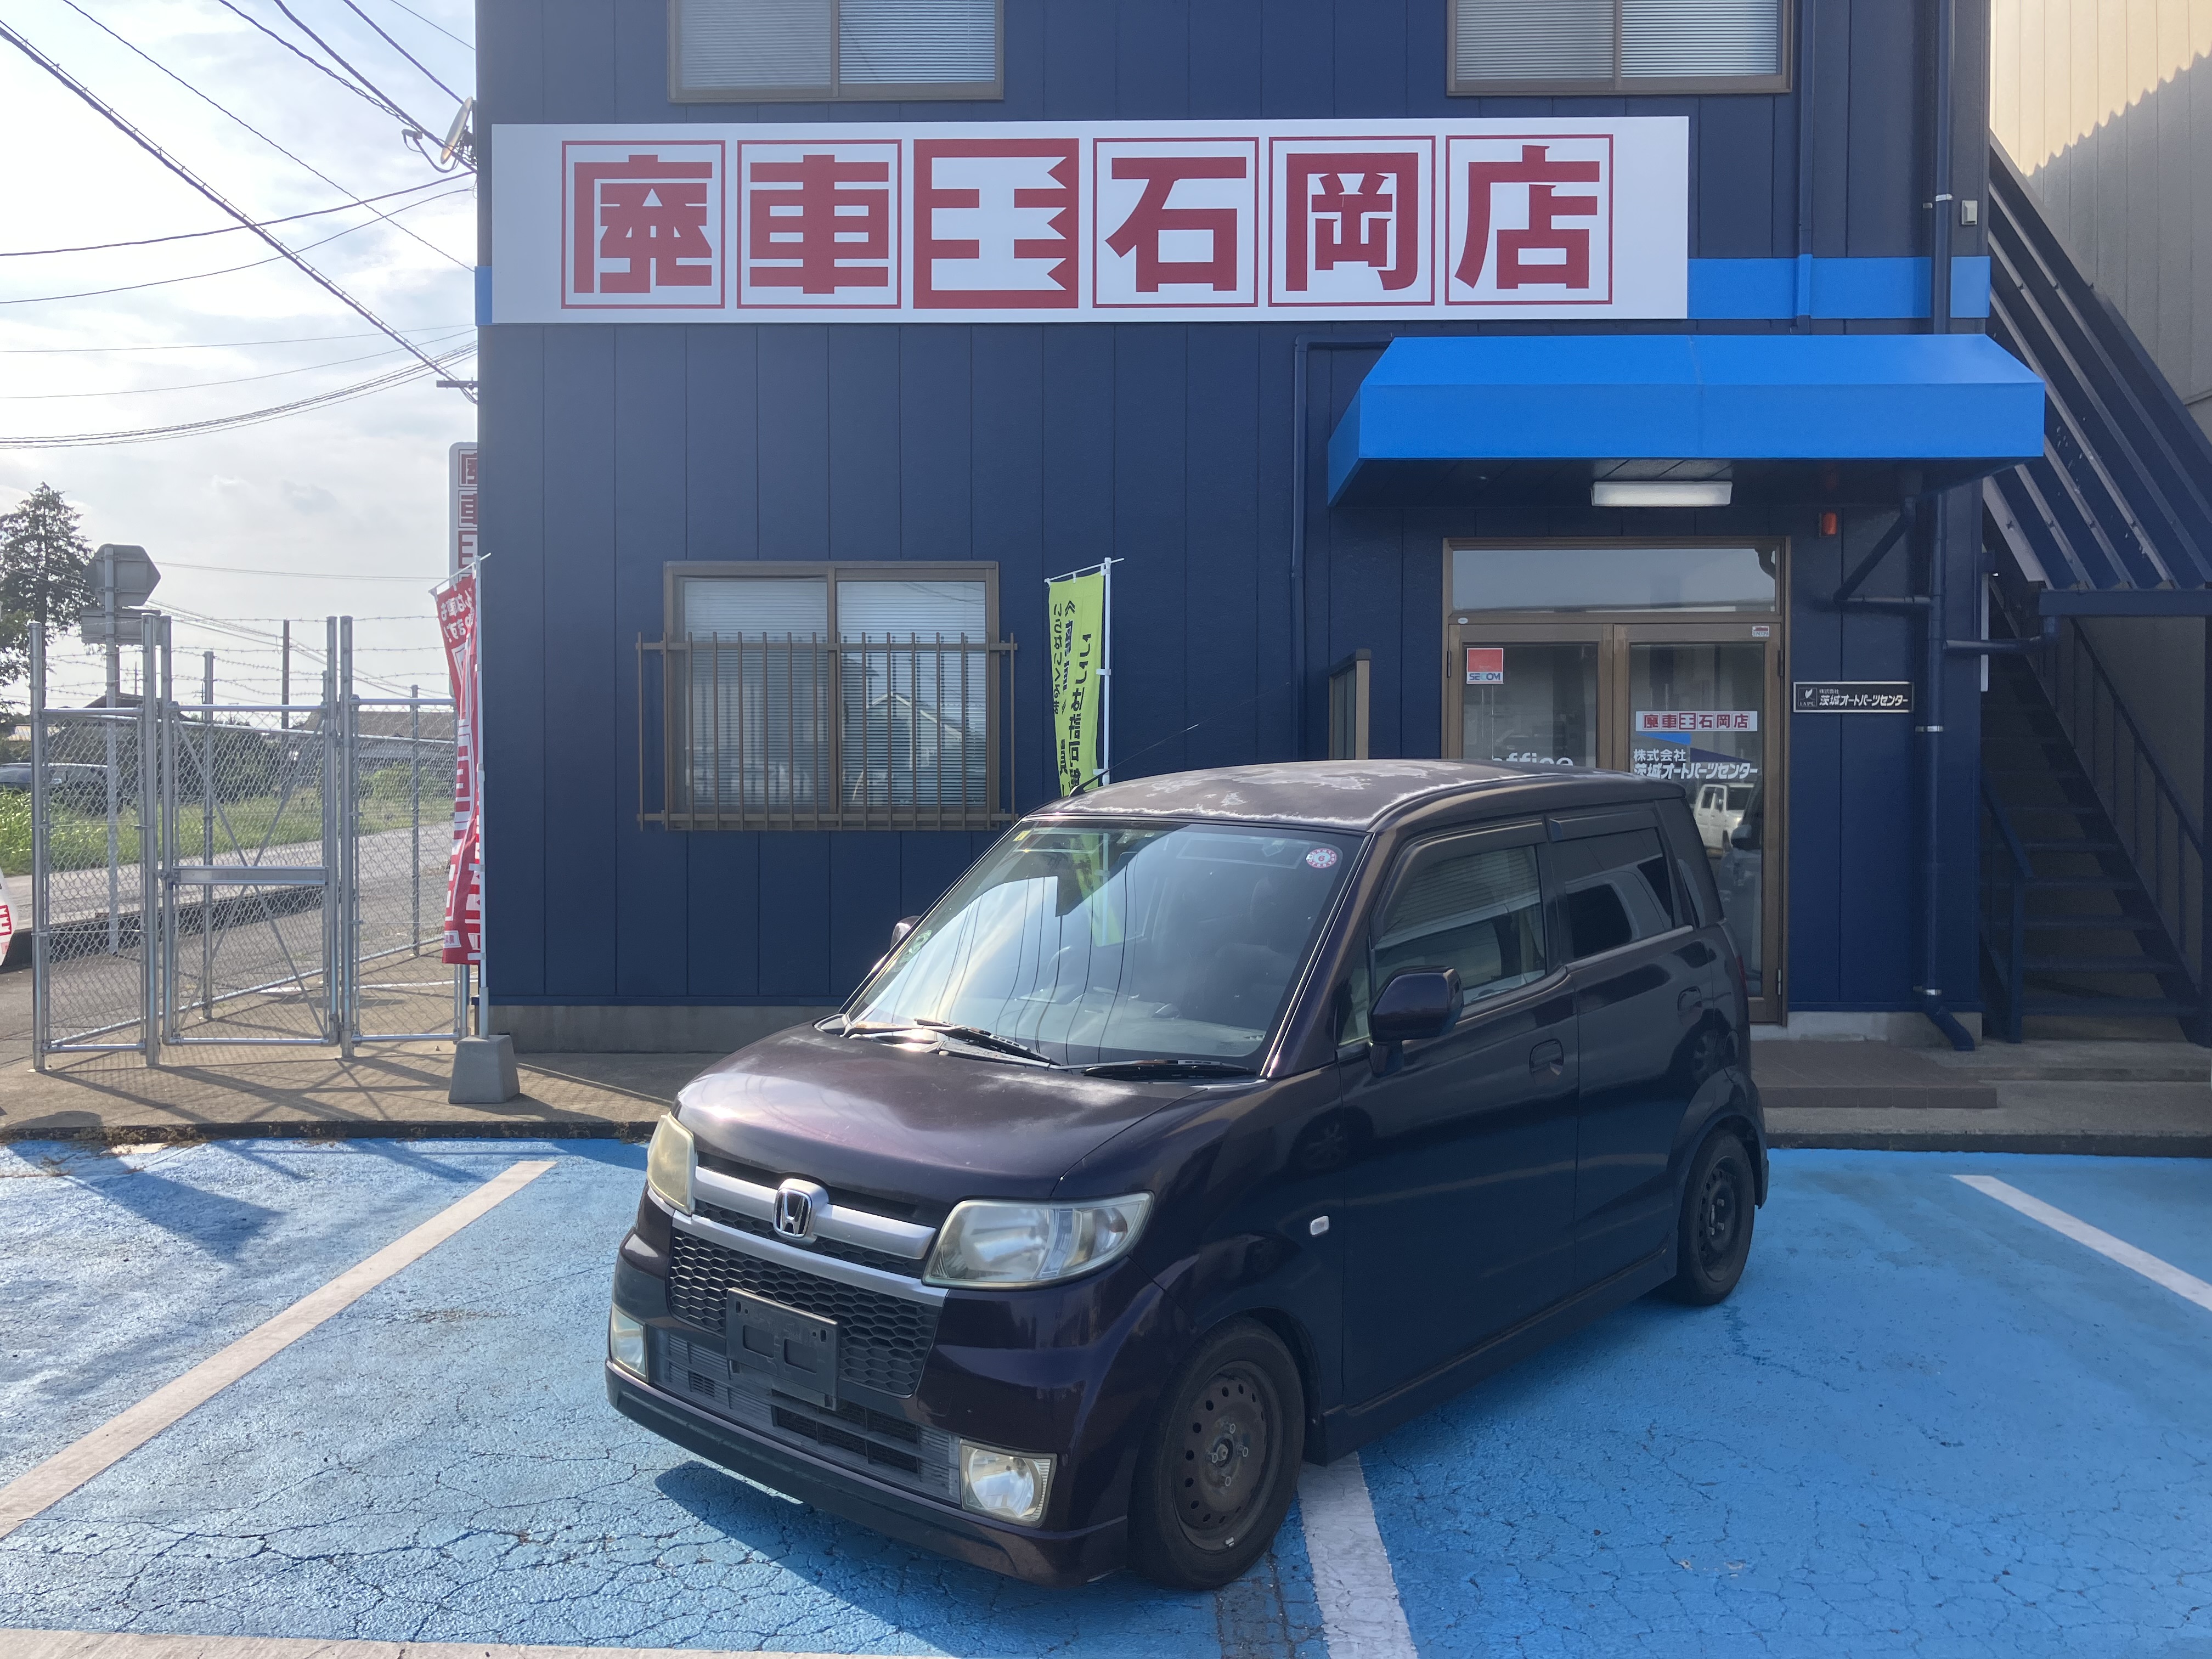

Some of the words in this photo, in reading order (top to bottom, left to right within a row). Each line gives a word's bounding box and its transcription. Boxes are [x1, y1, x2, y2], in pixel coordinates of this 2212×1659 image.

[1469, 673, 1500, 681] SECOM
[1819, 694, 1909, 707] 茨城オートパーツセンター
[1633, 748, 1686, 762] 株式会社
